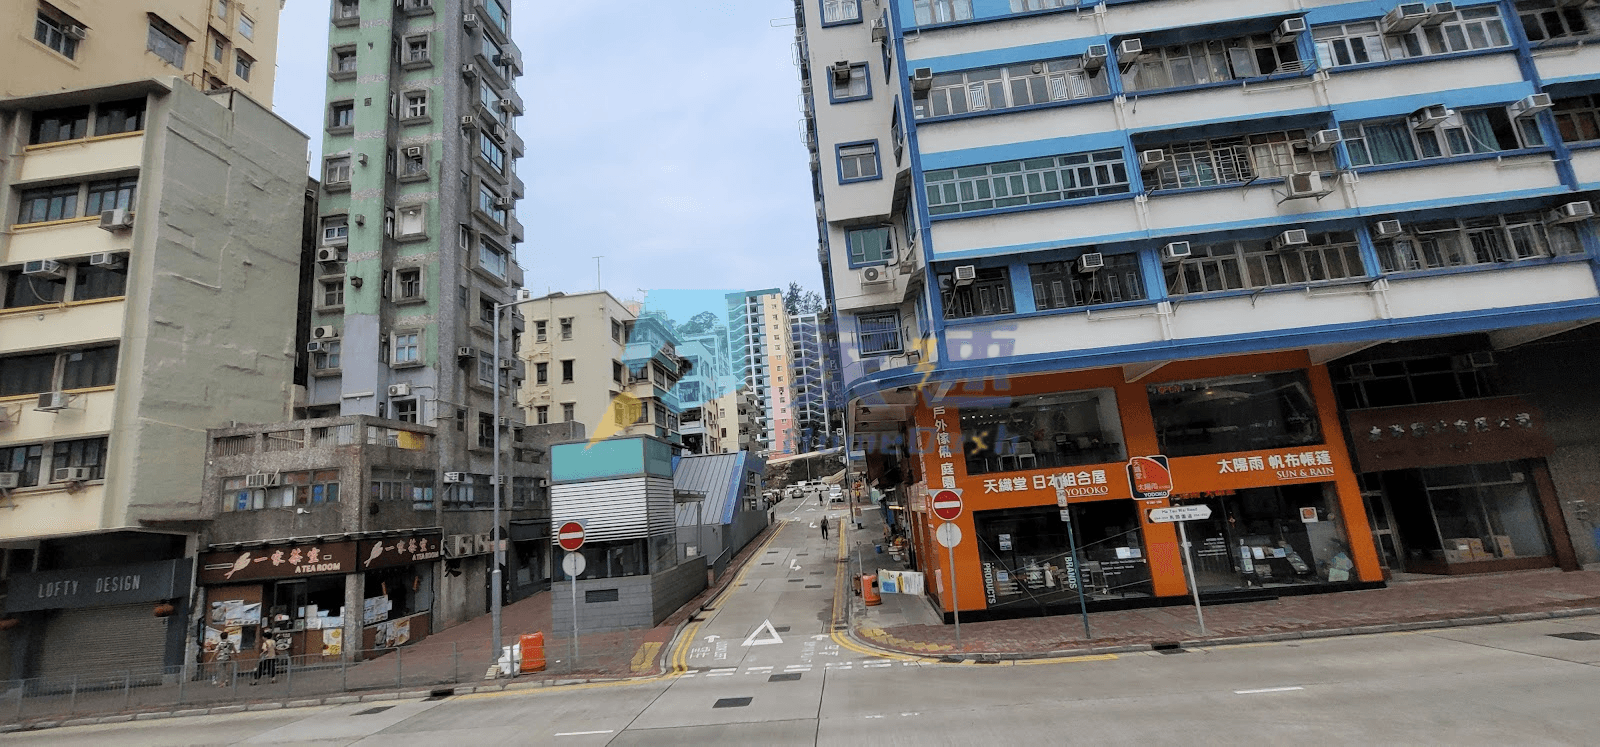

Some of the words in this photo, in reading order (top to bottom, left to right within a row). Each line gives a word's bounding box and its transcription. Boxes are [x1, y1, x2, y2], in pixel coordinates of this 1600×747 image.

[1217, 455, 1265, 474] 太陽雨
[1277, 469, 1297, 478] SUN
[1299, 468, 1307, 477] &
[1309, 466, 1335, 476] RAIN
[1065, 485, 1108, 496] YODOKO
[253, 546, 321, 567] 一家茶室
[295, 566, 301, 574] A
[301, 564, 316, 574] TEA
[316, 562, 341, 573] ROOM
[38, 580, 79, 599] LOFTY
[95, 574, 141, 594] DESIGN
